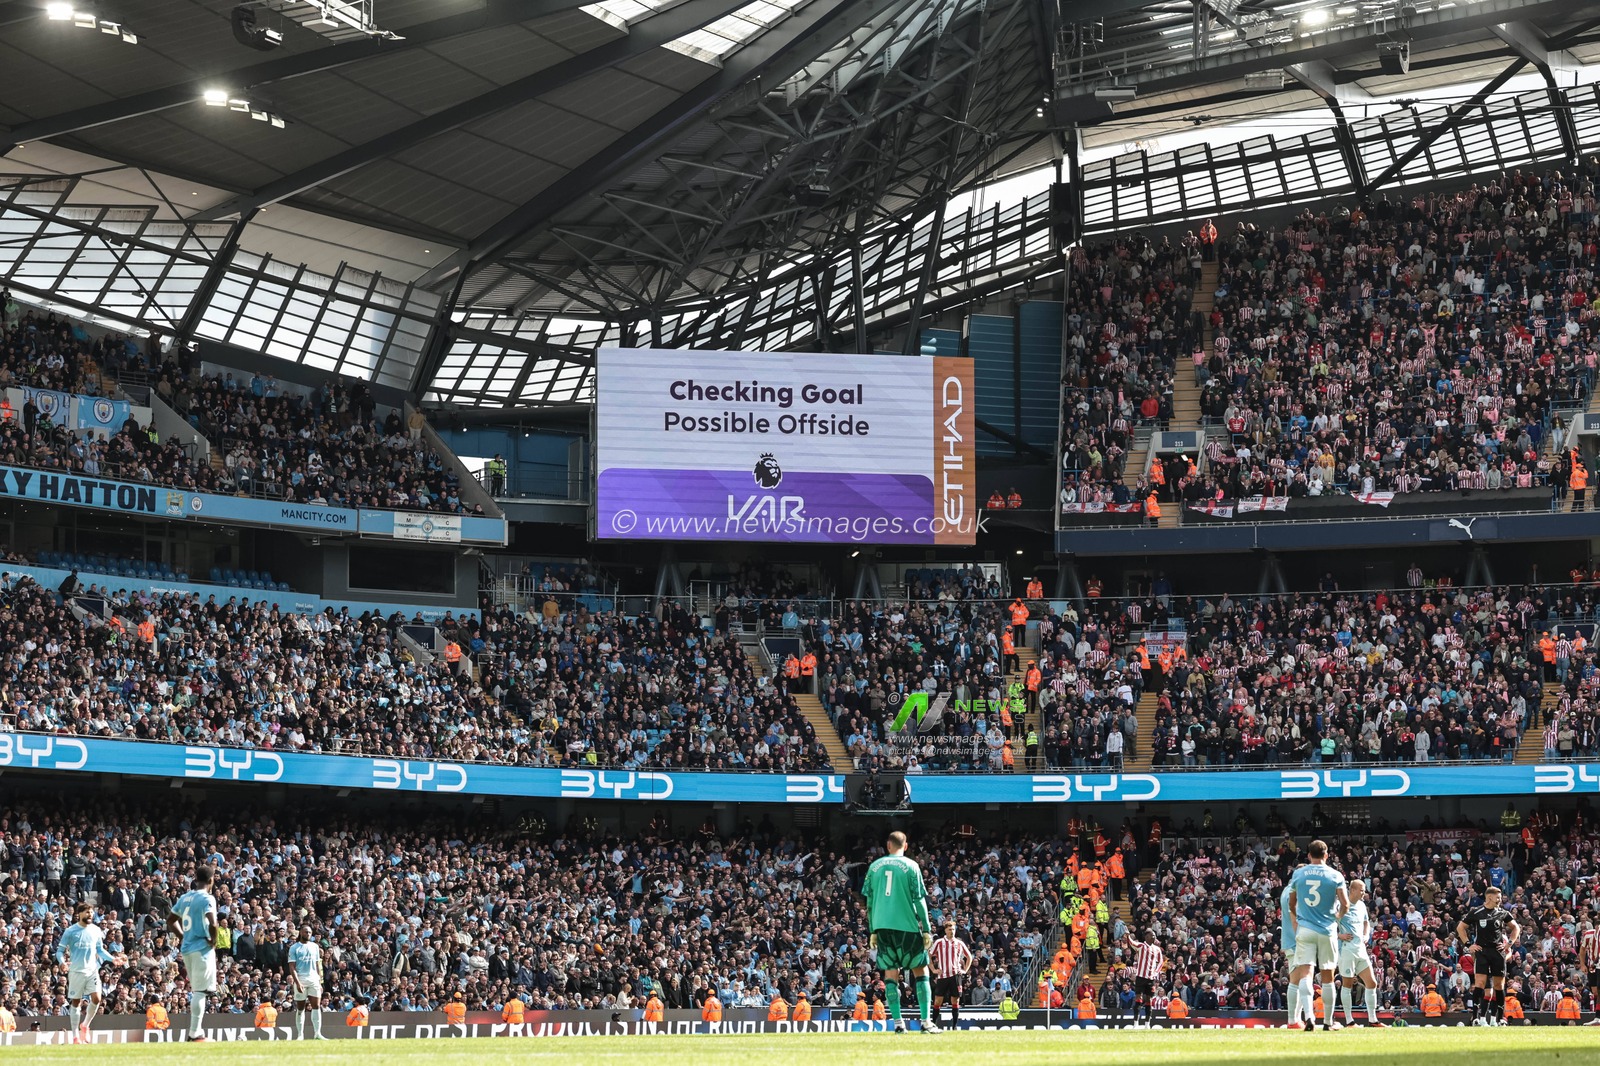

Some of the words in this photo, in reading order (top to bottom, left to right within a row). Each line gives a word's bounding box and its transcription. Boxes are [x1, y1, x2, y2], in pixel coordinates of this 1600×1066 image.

[669, 380, 792, 408] Checking
[801, 383, 864, 405] Goal
[663, 411, 770, 434] Possible
[777, 413, 870, 436] Offside
[942, 375, 963, 525] ETIHAD
[39, 474, 156, 513] HATTON
[281, 508, 347, 524] MANCITY.COM
[727, 494, 805, 522] VAR
[185, 747, 284, 782] BYD
[373, 759, 468, 792] BYD
[561, 769, 674, 800] BYD
[1032, 774, 1161, 802] BYD
[1280, 769, 1411, 799] BYD
[884, 870, 893, 896] 1
[1304, 880, 1321, 907] 3
[182, 906, 193, 932] 6
